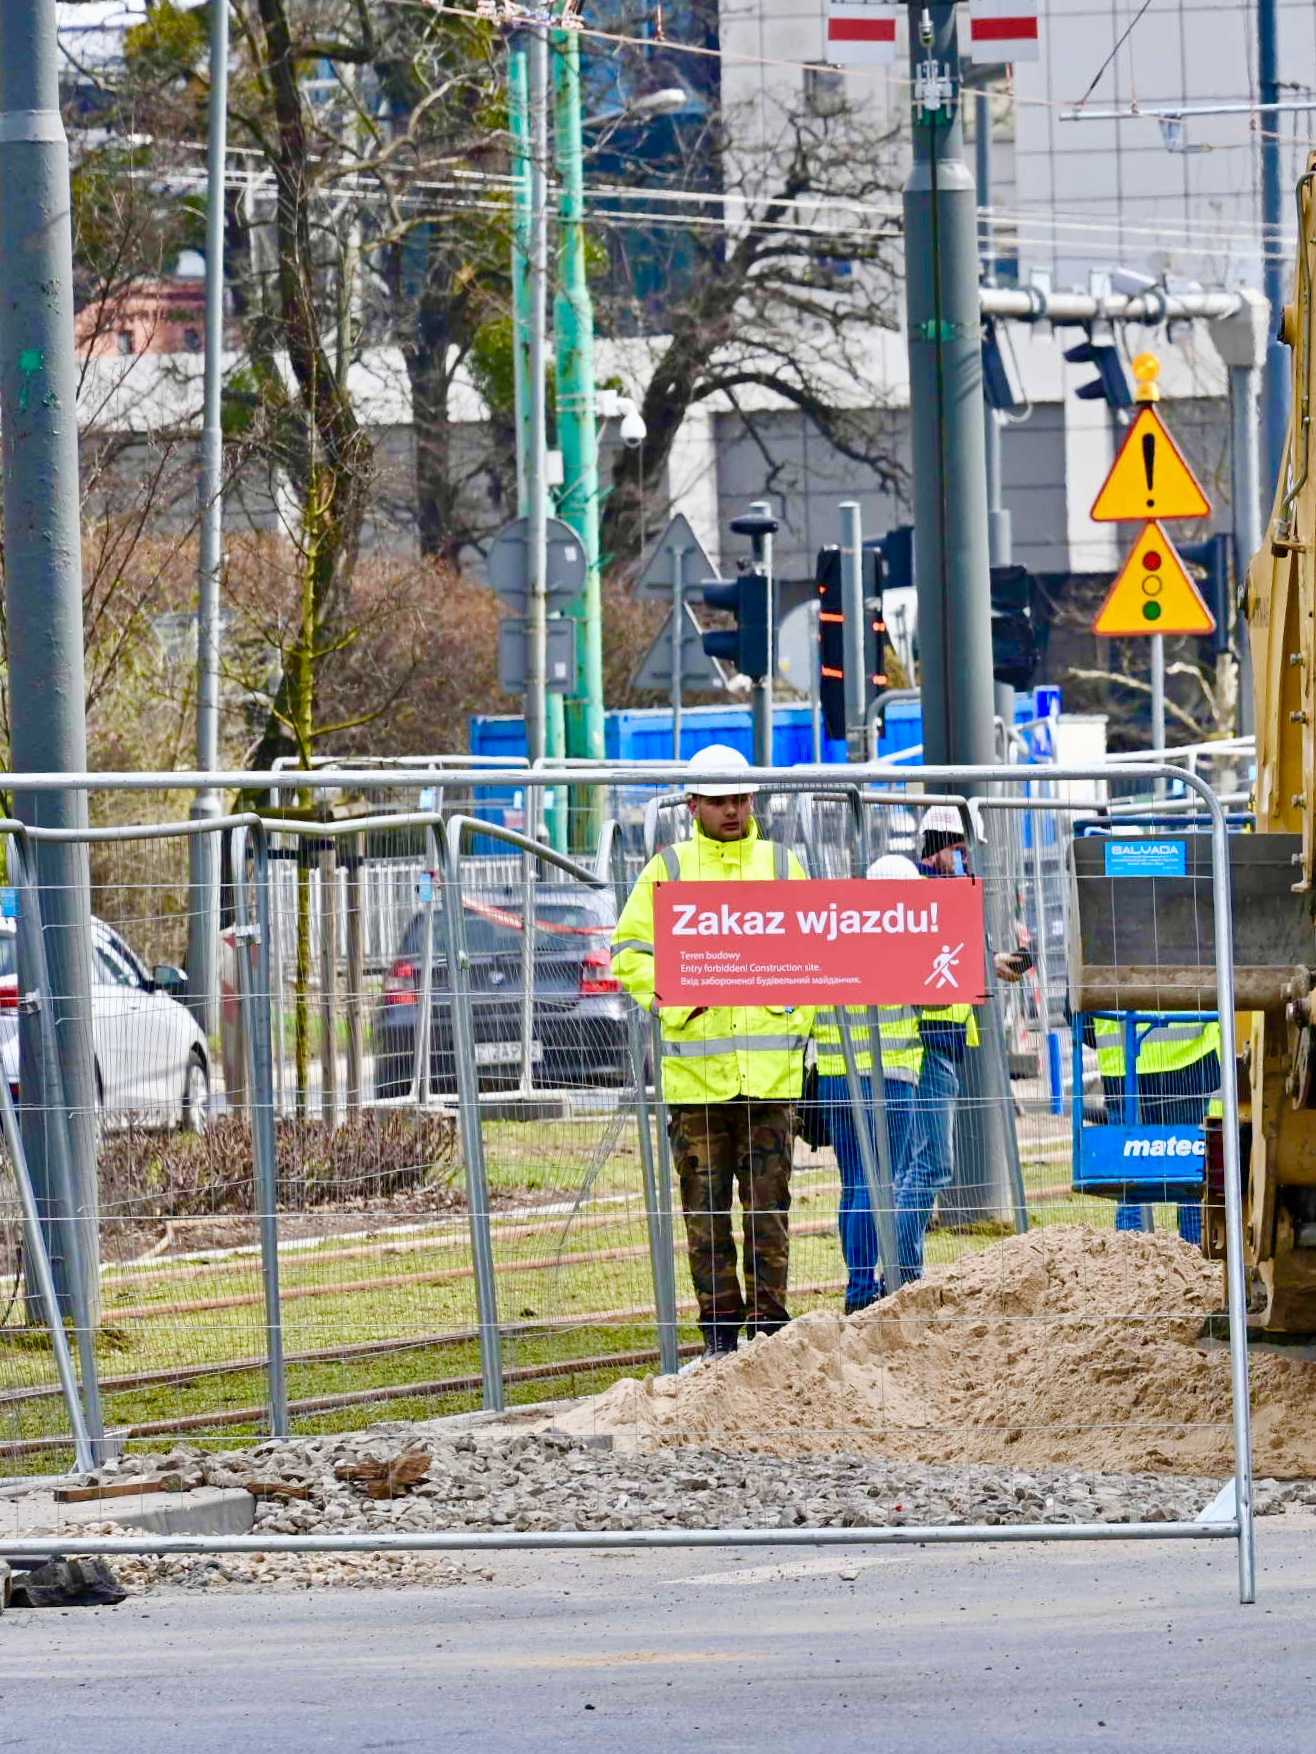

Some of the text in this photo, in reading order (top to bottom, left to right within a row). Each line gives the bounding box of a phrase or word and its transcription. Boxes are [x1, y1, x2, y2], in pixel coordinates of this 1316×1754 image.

[671, 902, 939, 941] Zakaz wjazdu!
[680, 950, 741, 961] Teren budowy
[680, 963, 822, 974] Entry forbidden! Construction site.
[680, 977, 700, 987] Вхід
[700, 975, 755, 987] заборонено!
[756, 976, 811, 987] Будівельний
